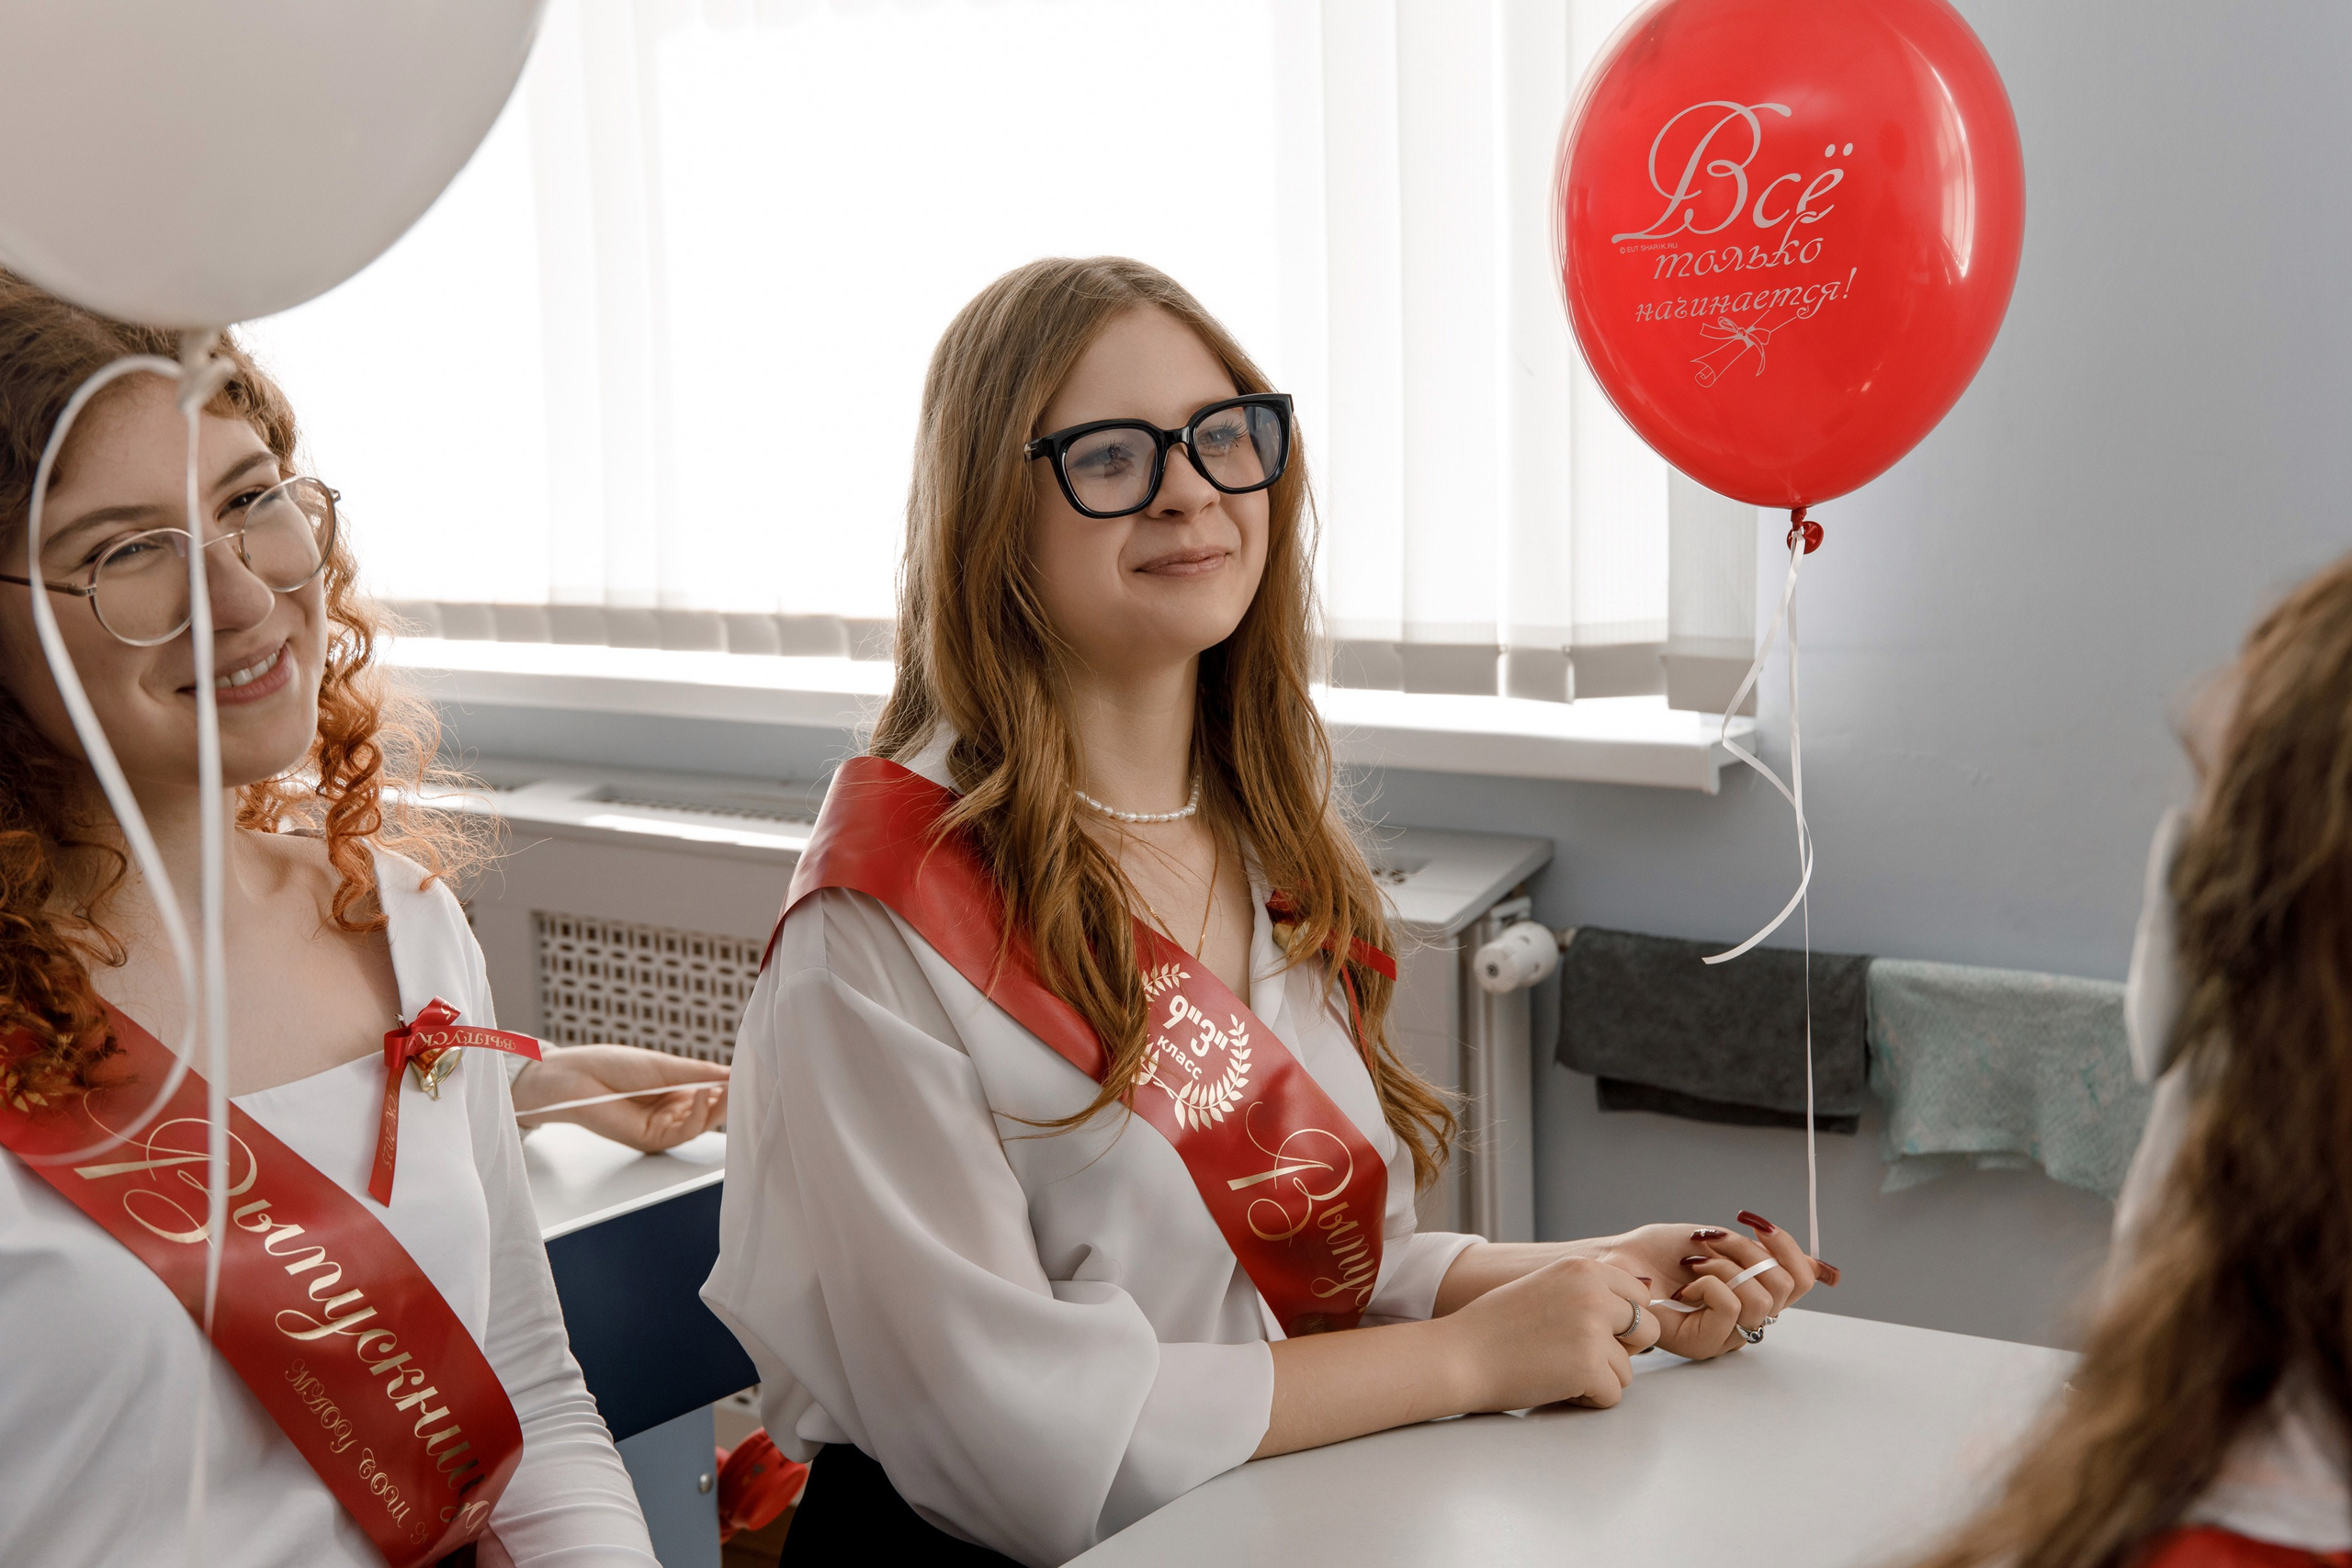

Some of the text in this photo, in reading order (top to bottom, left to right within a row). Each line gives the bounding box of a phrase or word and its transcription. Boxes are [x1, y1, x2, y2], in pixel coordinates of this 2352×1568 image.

[1611, 100, 1853, 243] Всё
[1653, 210, 1824, 279] только
[1635, 267, 1857, 322] начинается!
[415, 1029, 516, 1051] ВЫПУСК
[1156, 1034, 1203, 1080] класс
[381, 1125, 396, 1170] 2025
[358, 1447, 413, 1529] СОШ
